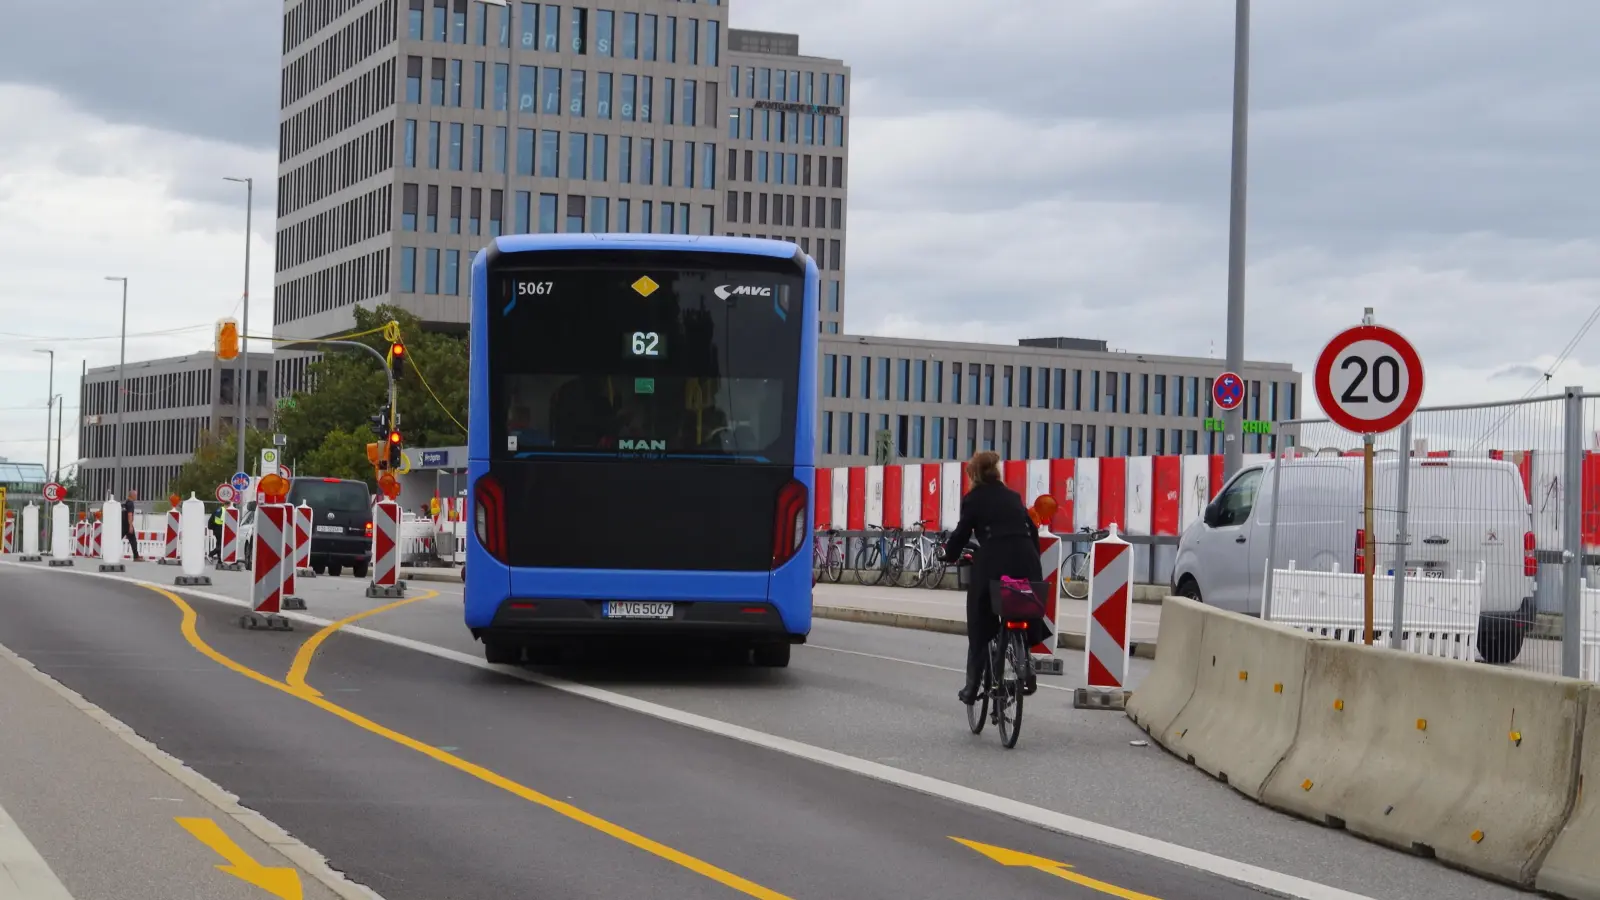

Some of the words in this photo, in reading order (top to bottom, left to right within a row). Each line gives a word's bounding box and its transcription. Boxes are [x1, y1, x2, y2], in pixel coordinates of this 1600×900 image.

[518, 282, 554, 295] 5067
[731, 286, 771, 296] MVG
[632, 332, 659, 355] 62
[1341, 355, 1400, 403] 20
[618, 439, 666, 450] MAN
[609, 601, 618, 614] M
[625, 602, 641, 615] VG
[642, 603, 671, 615] 5067
